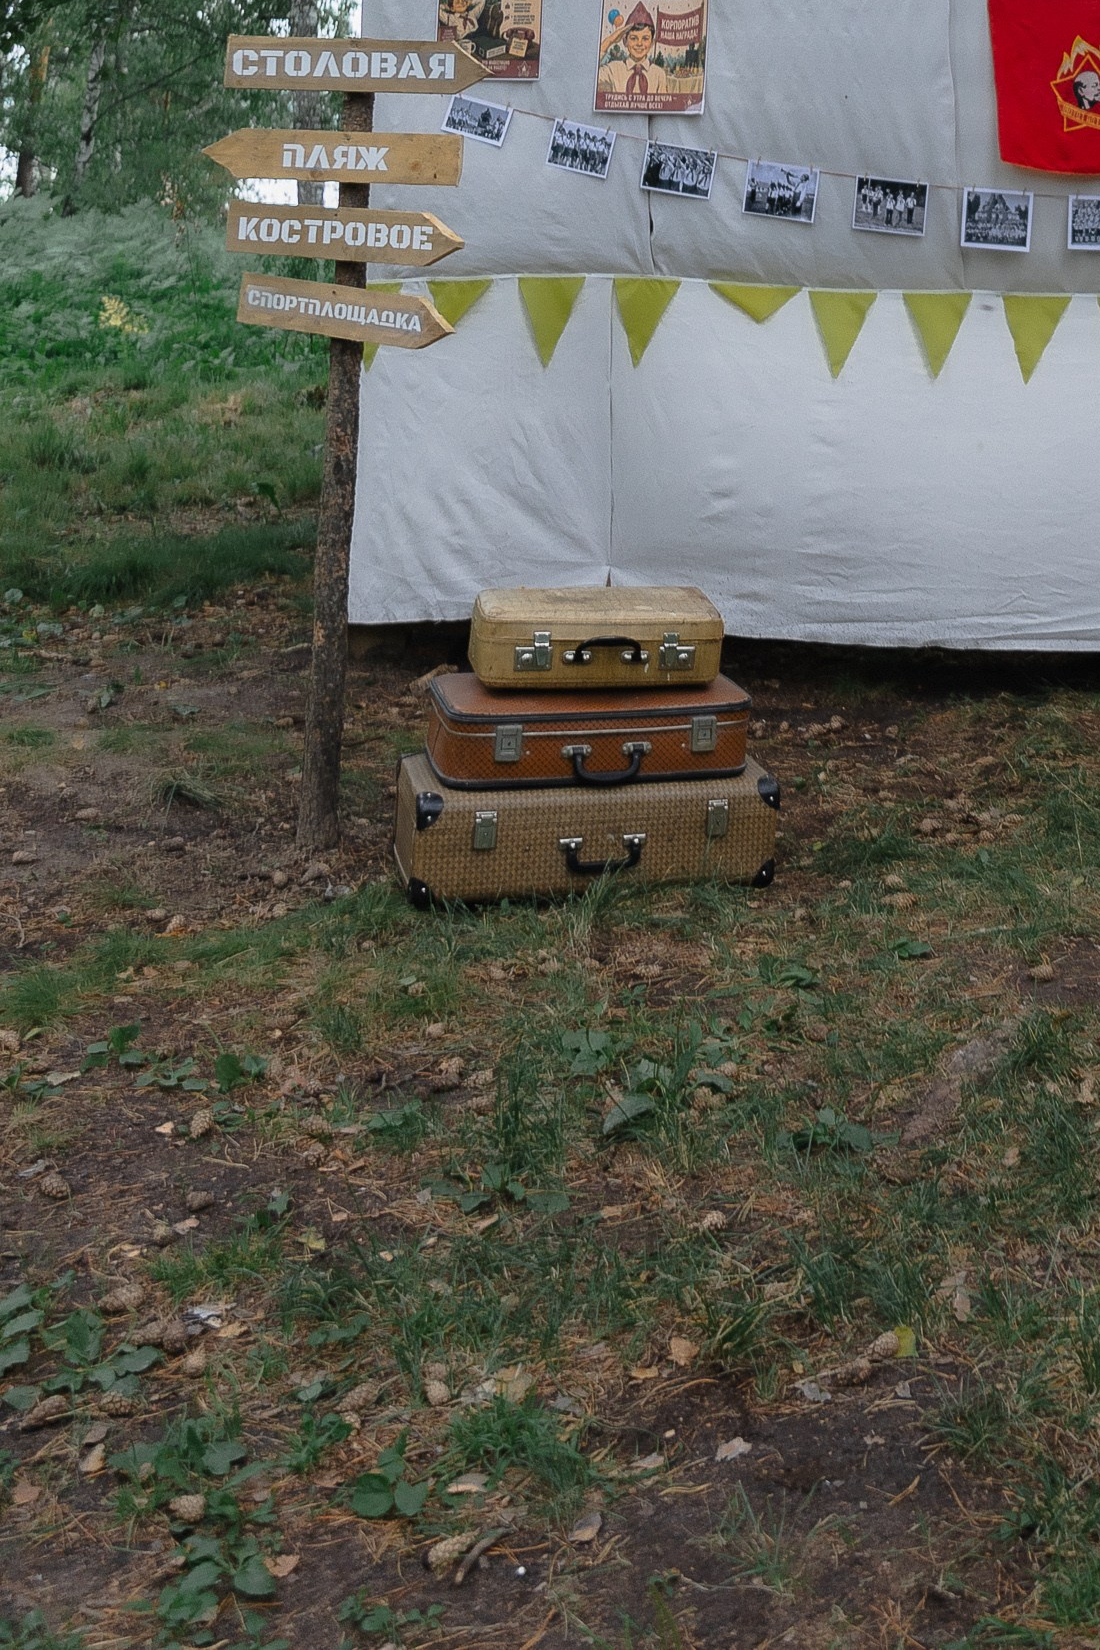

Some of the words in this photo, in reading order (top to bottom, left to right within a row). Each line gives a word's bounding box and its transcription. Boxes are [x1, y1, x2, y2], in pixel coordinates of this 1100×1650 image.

[661, 14, 700, 30] КОРПОРАТИВ
[660, 30, 675, 40] НАША
[232, 49, 455, 80] СТОЛОВАЯ
[604, 101, 629, 109] ОТДЫХАЙ
[605, 93, 628, 101] ТРУДИСЬ
[282, 143, 389, 171] ПЛЯЖ
[237, 216, 433, 251] КОСТРОВОЕ
[247, 288, 422, 332] СПОРТПЛОЩАДКА
